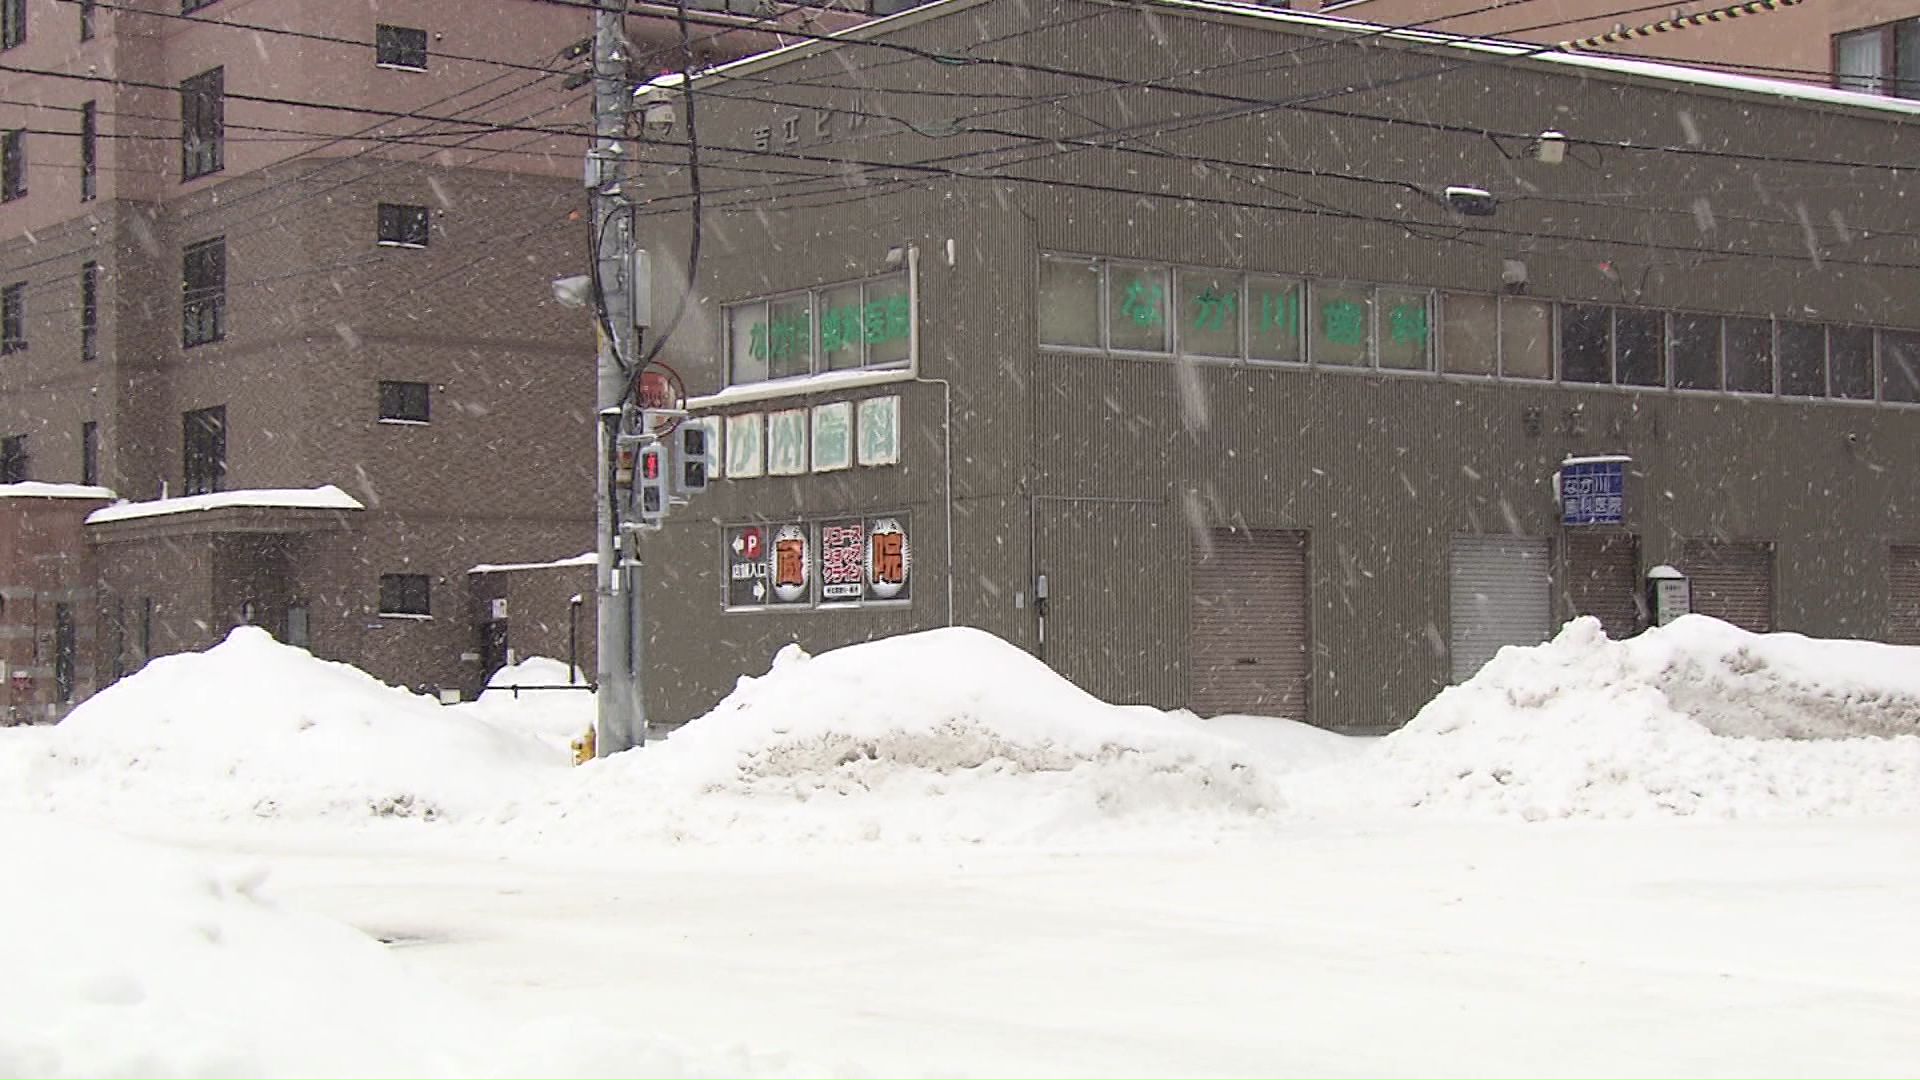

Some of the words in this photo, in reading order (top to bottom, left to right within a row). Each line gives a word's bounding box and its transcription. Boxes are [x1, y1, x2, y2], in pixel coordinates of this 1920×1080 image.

[1564, 477, 1609, 494] なが川
[1564, 496, 1622, 516] 歯科医院
[747, 535, 757, 554] P
